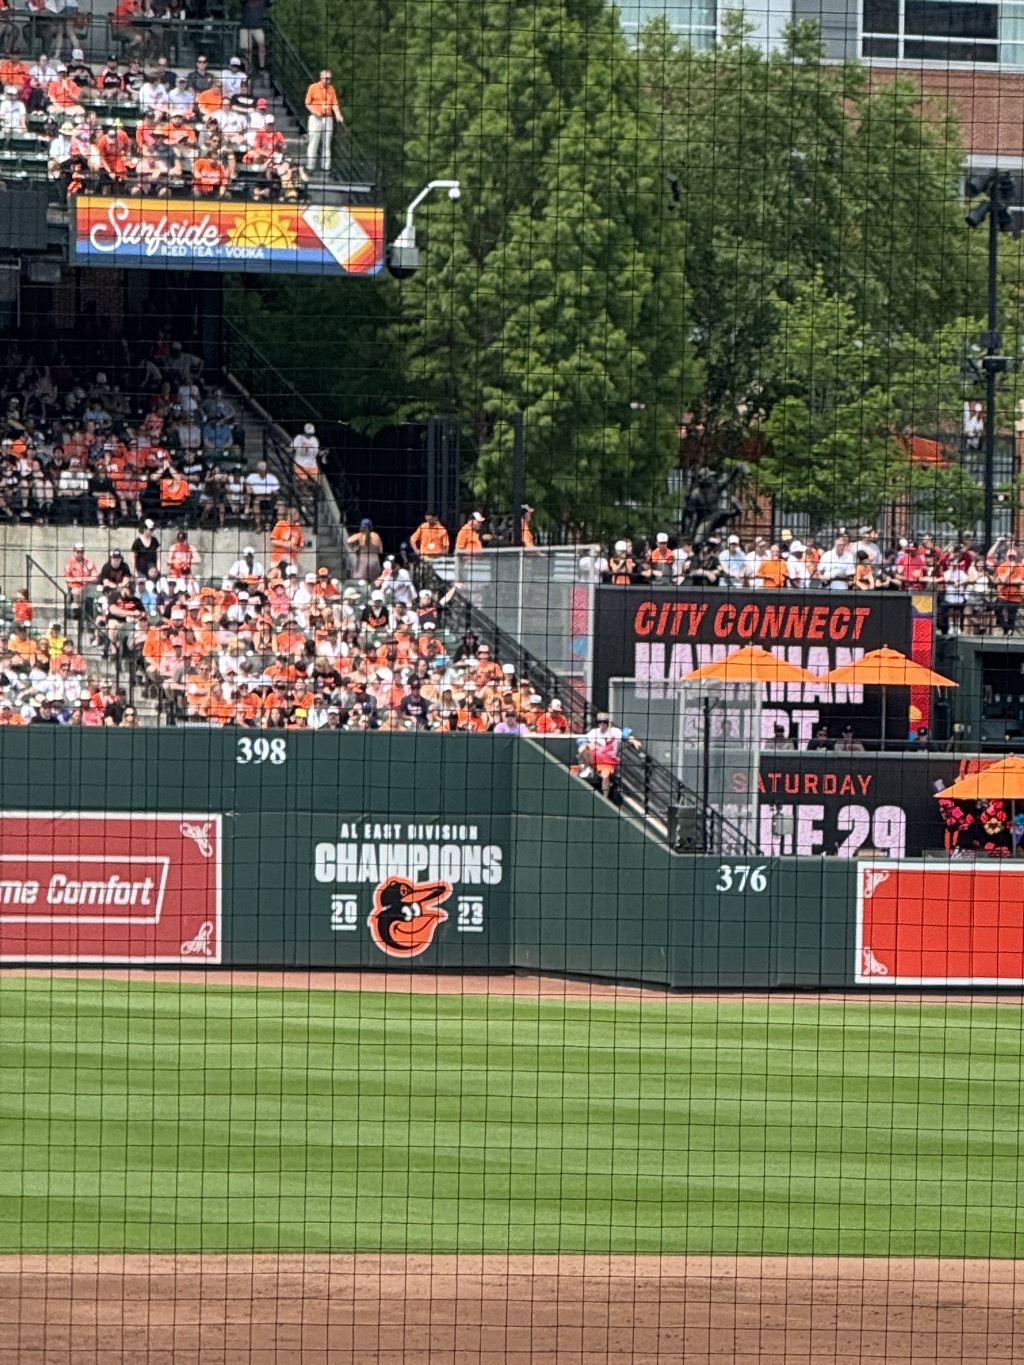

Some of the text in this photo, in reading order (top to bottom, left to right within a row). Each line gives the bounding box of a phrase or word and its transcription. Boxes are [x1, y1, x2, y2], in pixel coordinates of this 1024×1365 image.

[89, 199, 222, 257] Surfside
[191, 245, 213, 257] TEA
[225, 247, 265, 259] VODKA
[634, 601, 870, 640] CITY CONNECT
[235, 736, 287, 765] 398
[340, 823, 478, 841] AL EAST DIVISION
[837, 804, 907, 859] 29
[314, 842, 503, 886] CHAMPIONS
[715, 864, 767, 892] 376
[47, 873, 154, 905] Comfort
[331, 900, 484, 925] 20 23
